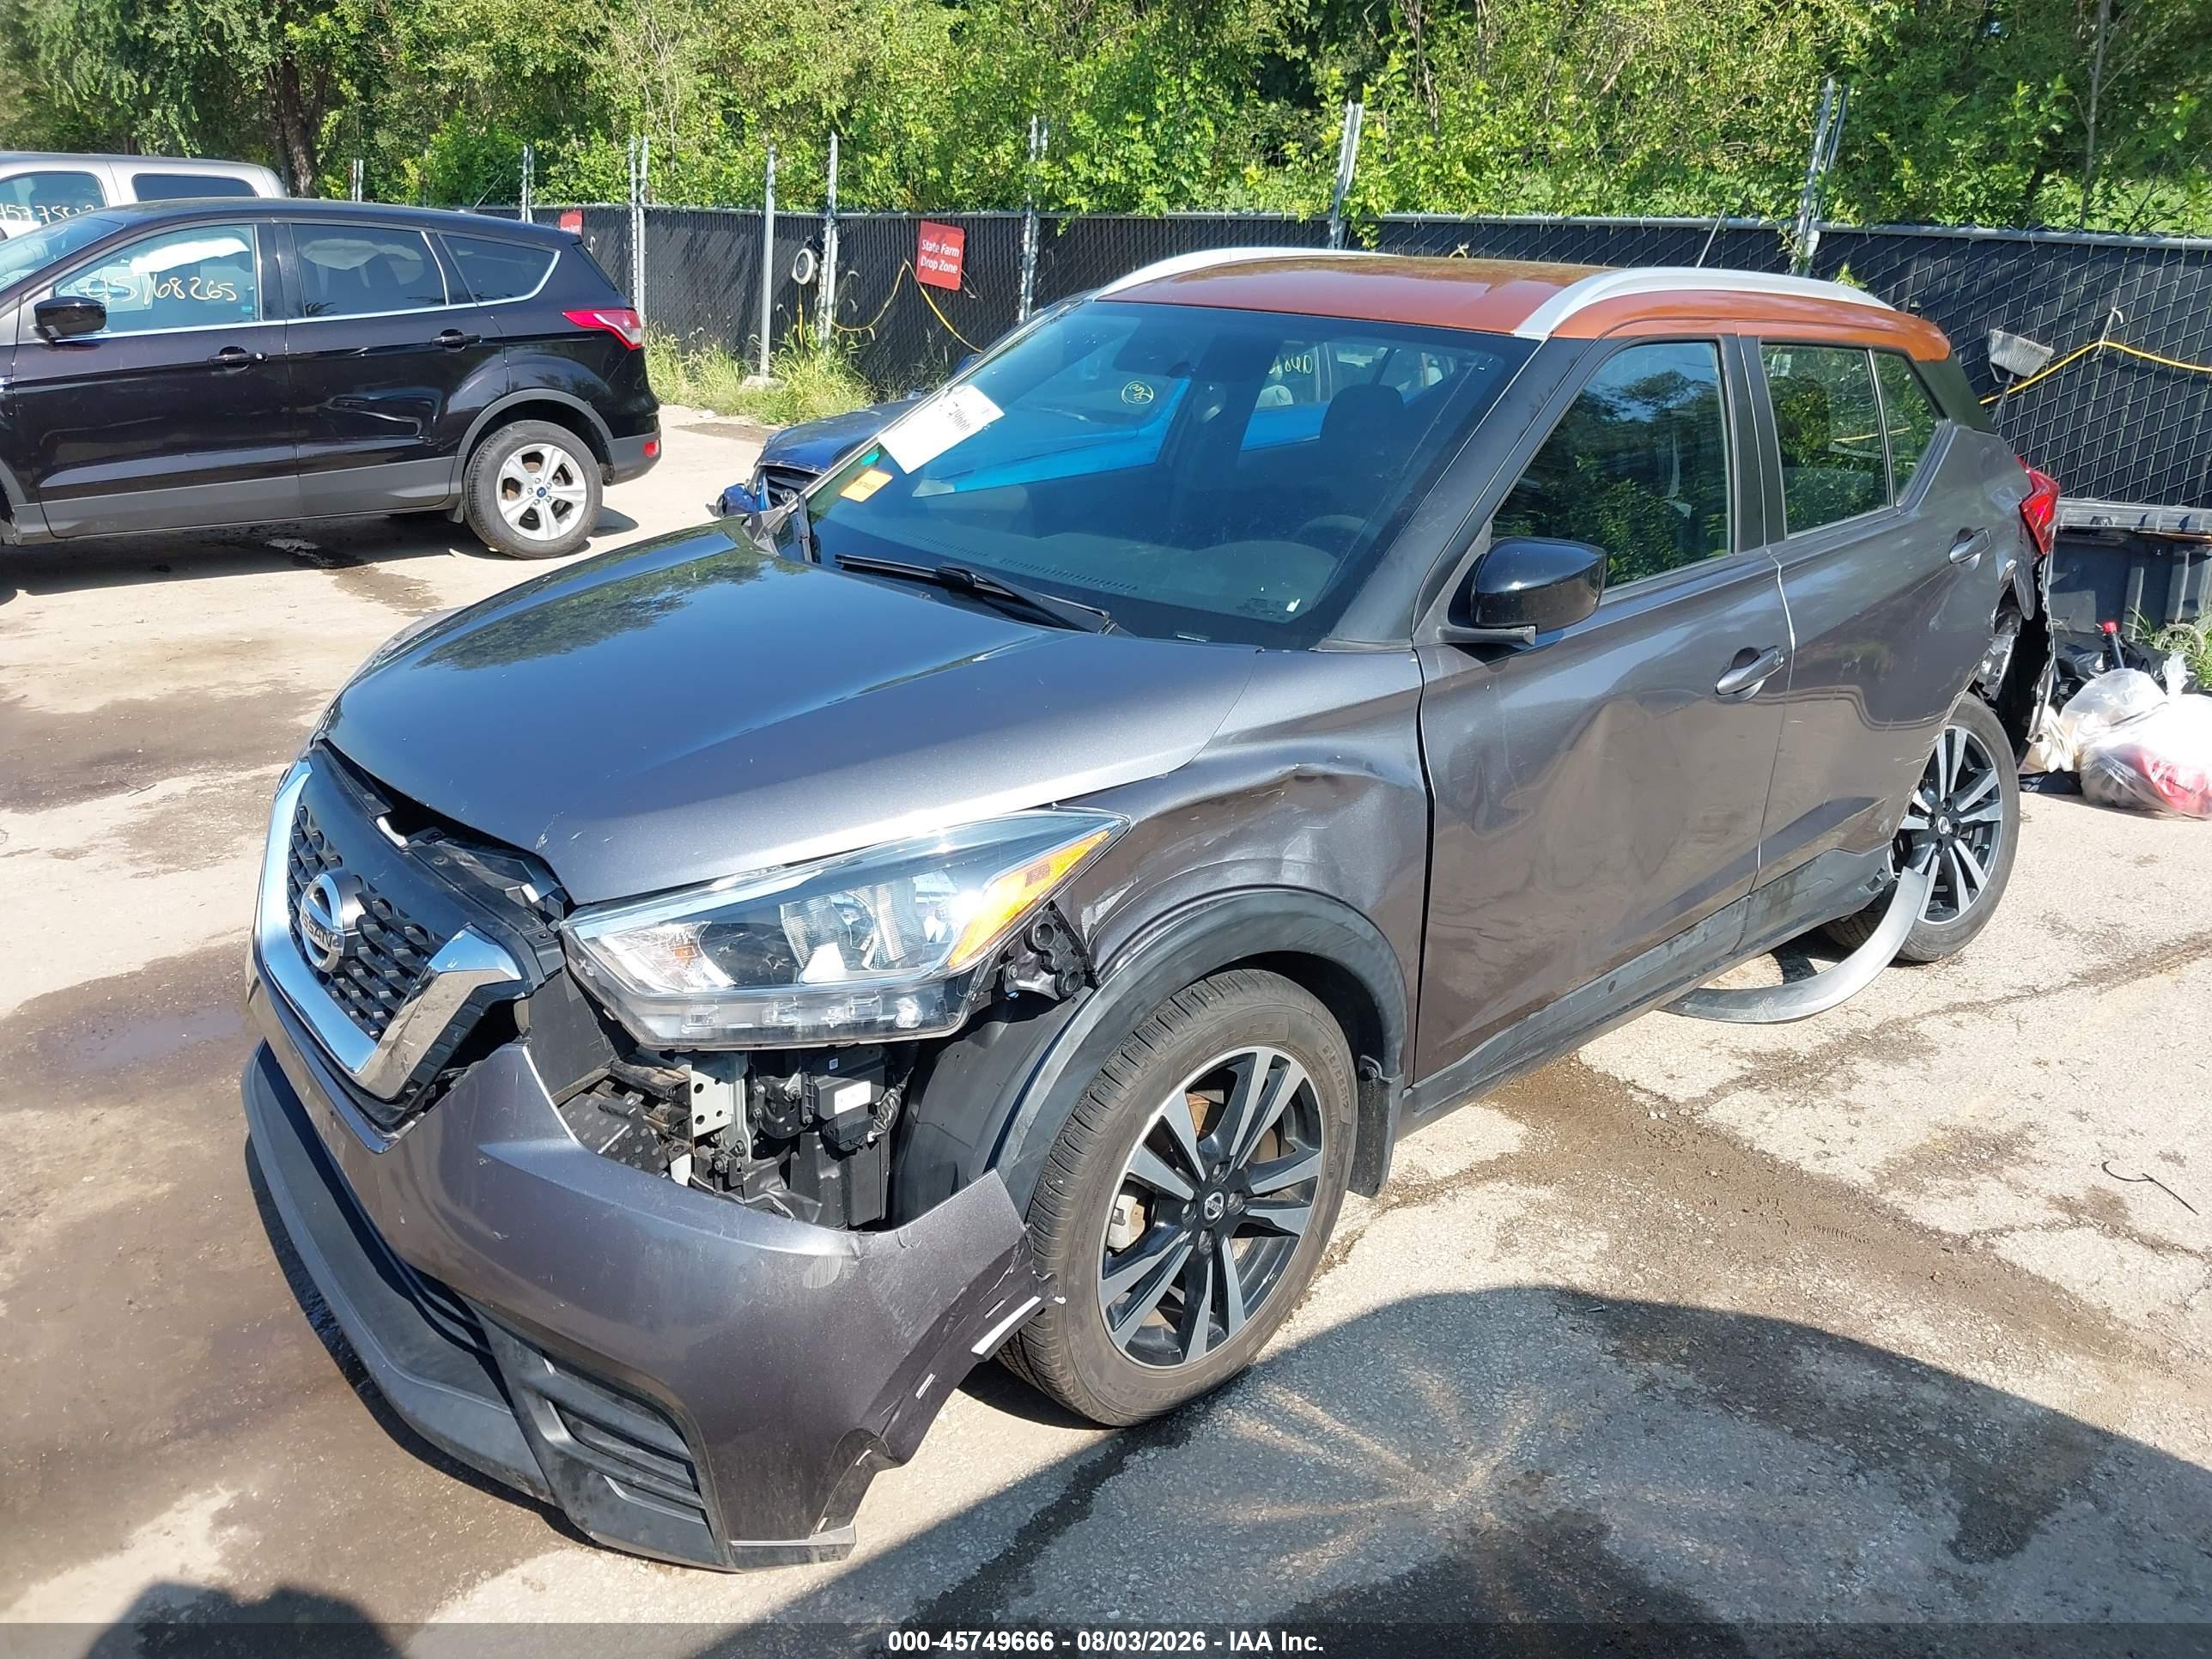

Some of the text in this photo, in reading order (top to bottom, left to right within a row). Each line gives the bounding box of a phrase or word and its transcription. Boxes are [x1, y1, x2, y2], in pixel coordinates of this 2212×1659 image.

[921, 239, 960, 257] State Farm
[921, 255, 958, 274] Drop Zone
[301, 908, 333, 948] NISSAN
